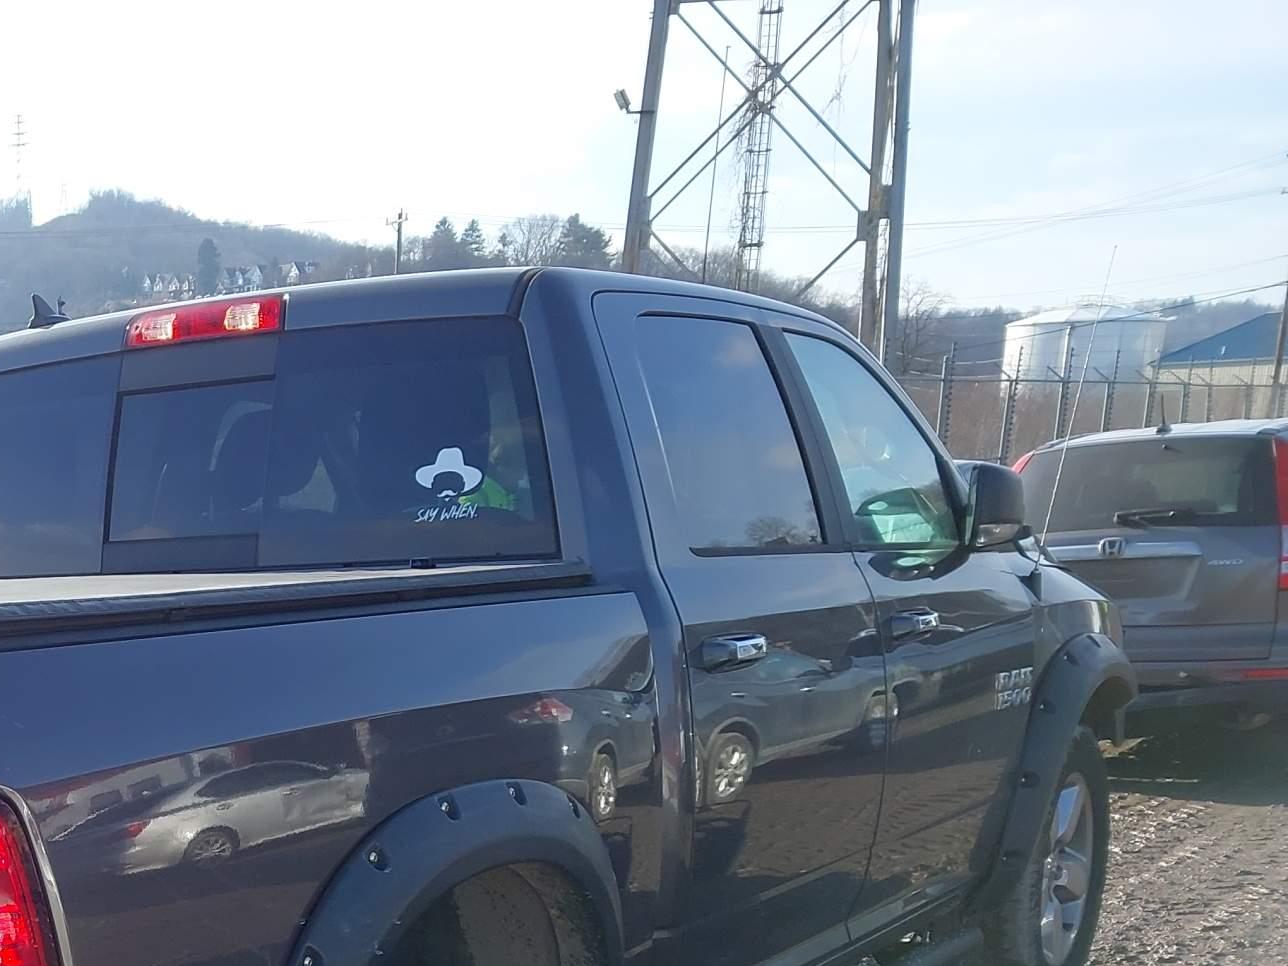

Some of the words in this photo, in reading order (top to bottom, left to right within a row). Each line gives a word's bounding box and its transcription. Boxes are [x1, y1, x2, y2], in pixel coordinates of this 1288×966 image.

[414, 507, 439, 522] SAY
[995, 666, 1033, 690] RAM
[994, 686, 1031, 710] 1500
